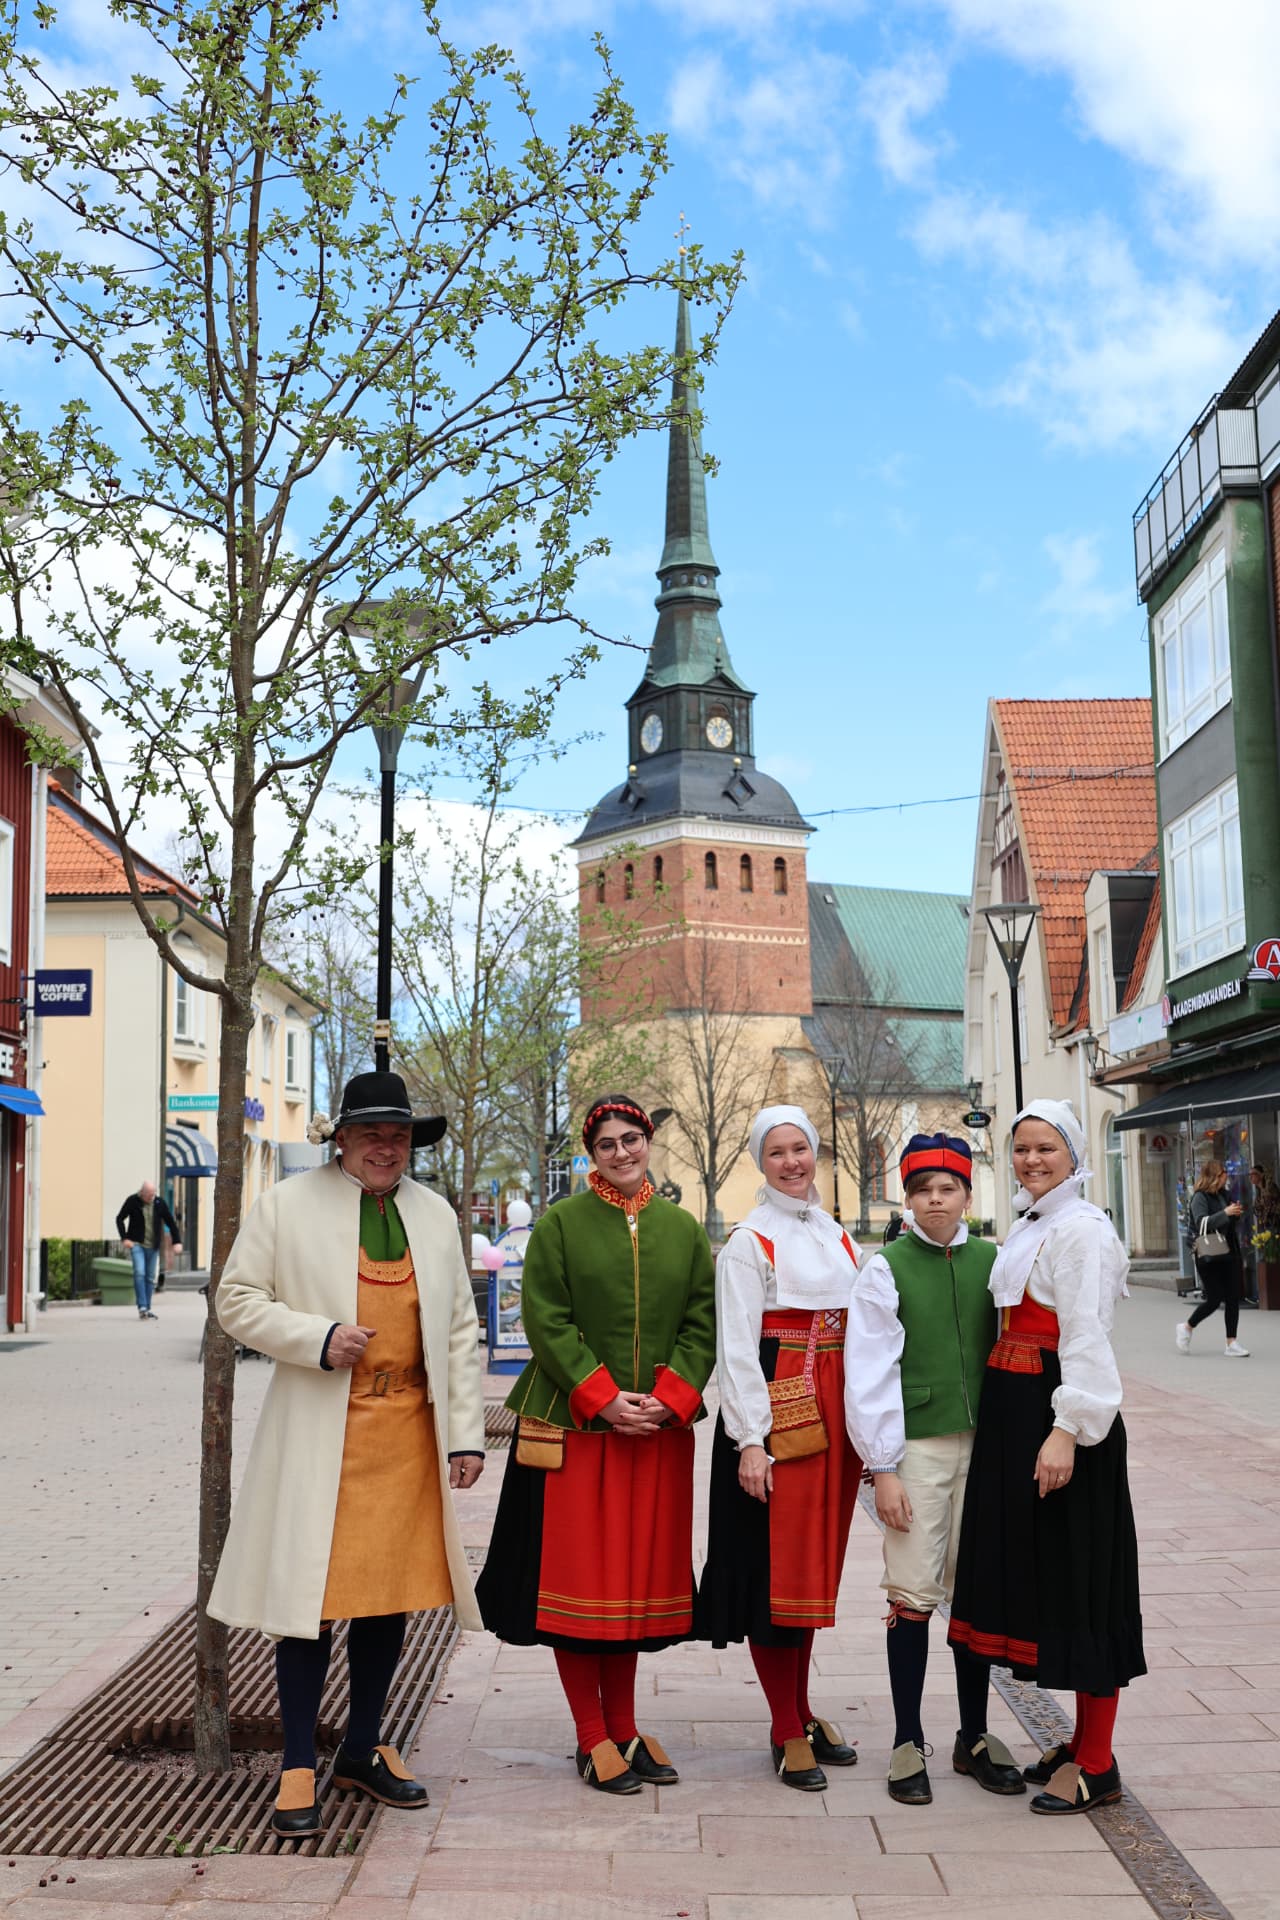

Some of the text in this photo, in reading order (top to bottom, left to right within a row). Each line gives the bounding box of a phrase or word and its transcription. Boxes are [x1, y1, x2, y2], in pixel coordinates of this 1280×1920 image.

[38, 983, 87, 993] WAYNE'S
[41, 992, 83, 1001] COFFEE
[1172, 978, 1241, 1020] AKADEMIBOKHANDELN
